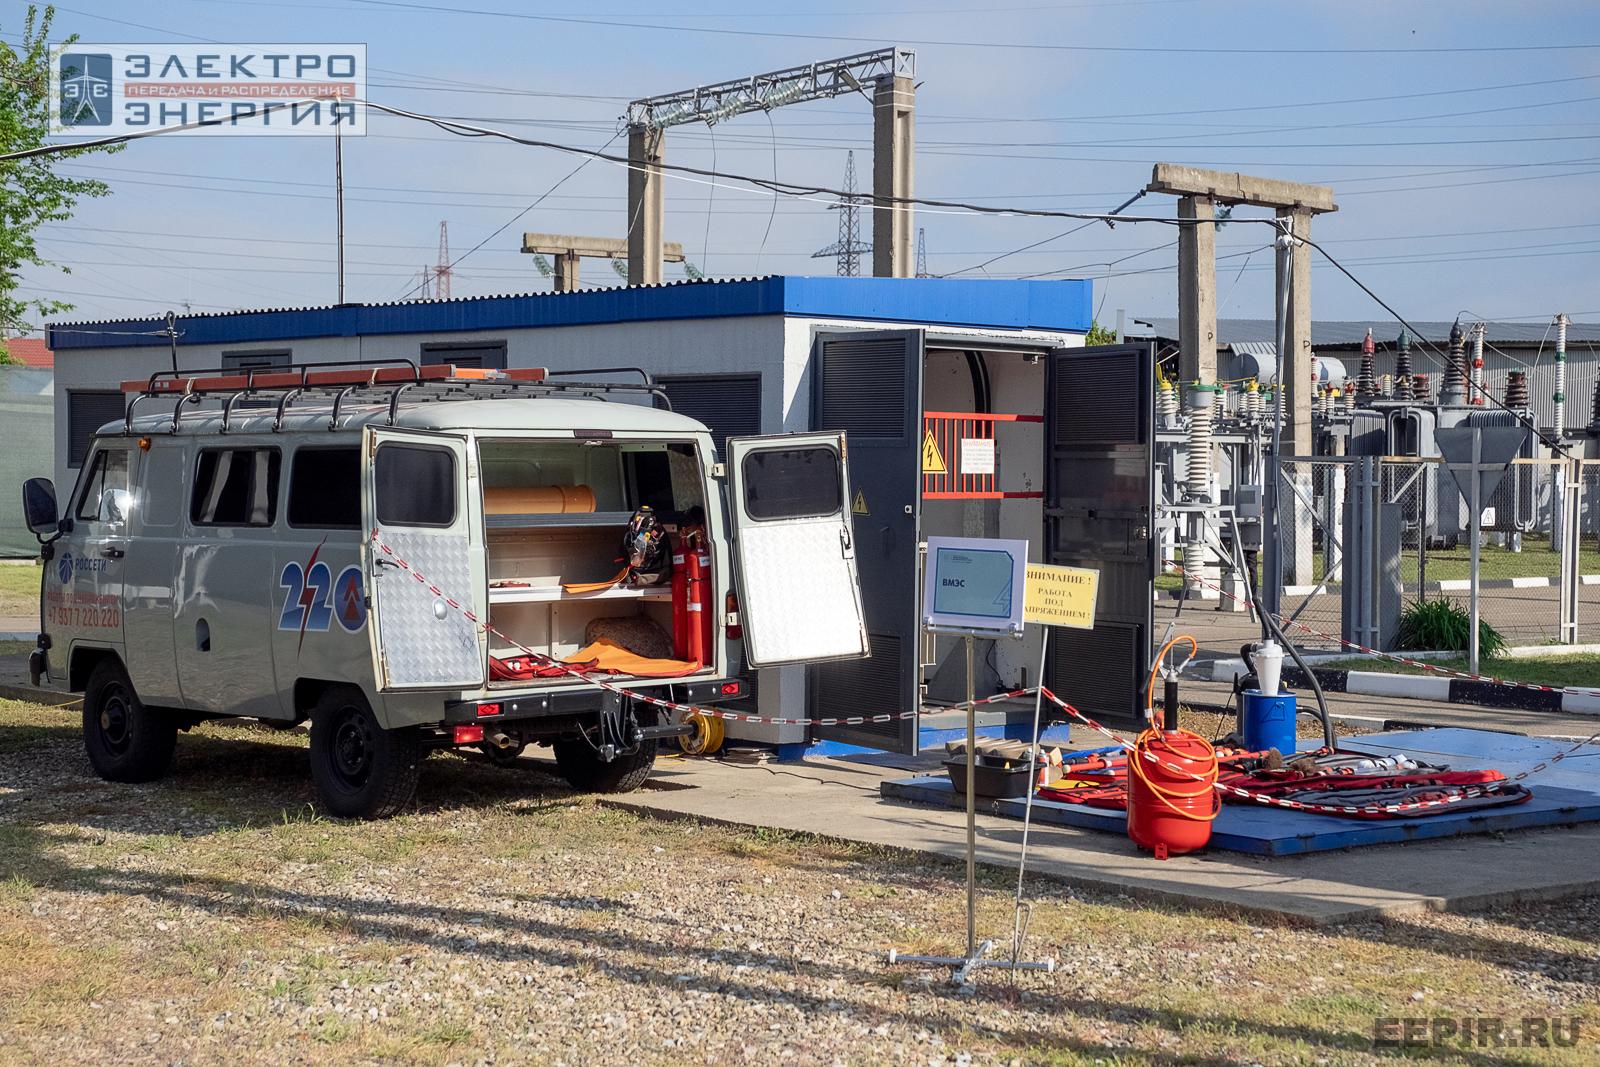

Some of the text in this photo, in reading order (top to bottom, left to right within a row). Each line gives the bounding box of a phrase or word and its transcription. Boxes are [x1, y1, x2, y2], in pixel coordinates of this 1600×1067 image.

[75, 558, 107, 571] РОССЕТИ
[942, 578, 966, 588] ВМЭС
[1037, 587, 1073, 598] РАБОТА
[1044, 597, 1064, 607] ПОД
[82, 608, 99, 627] 220
[101, 608, 119, 628] 220
